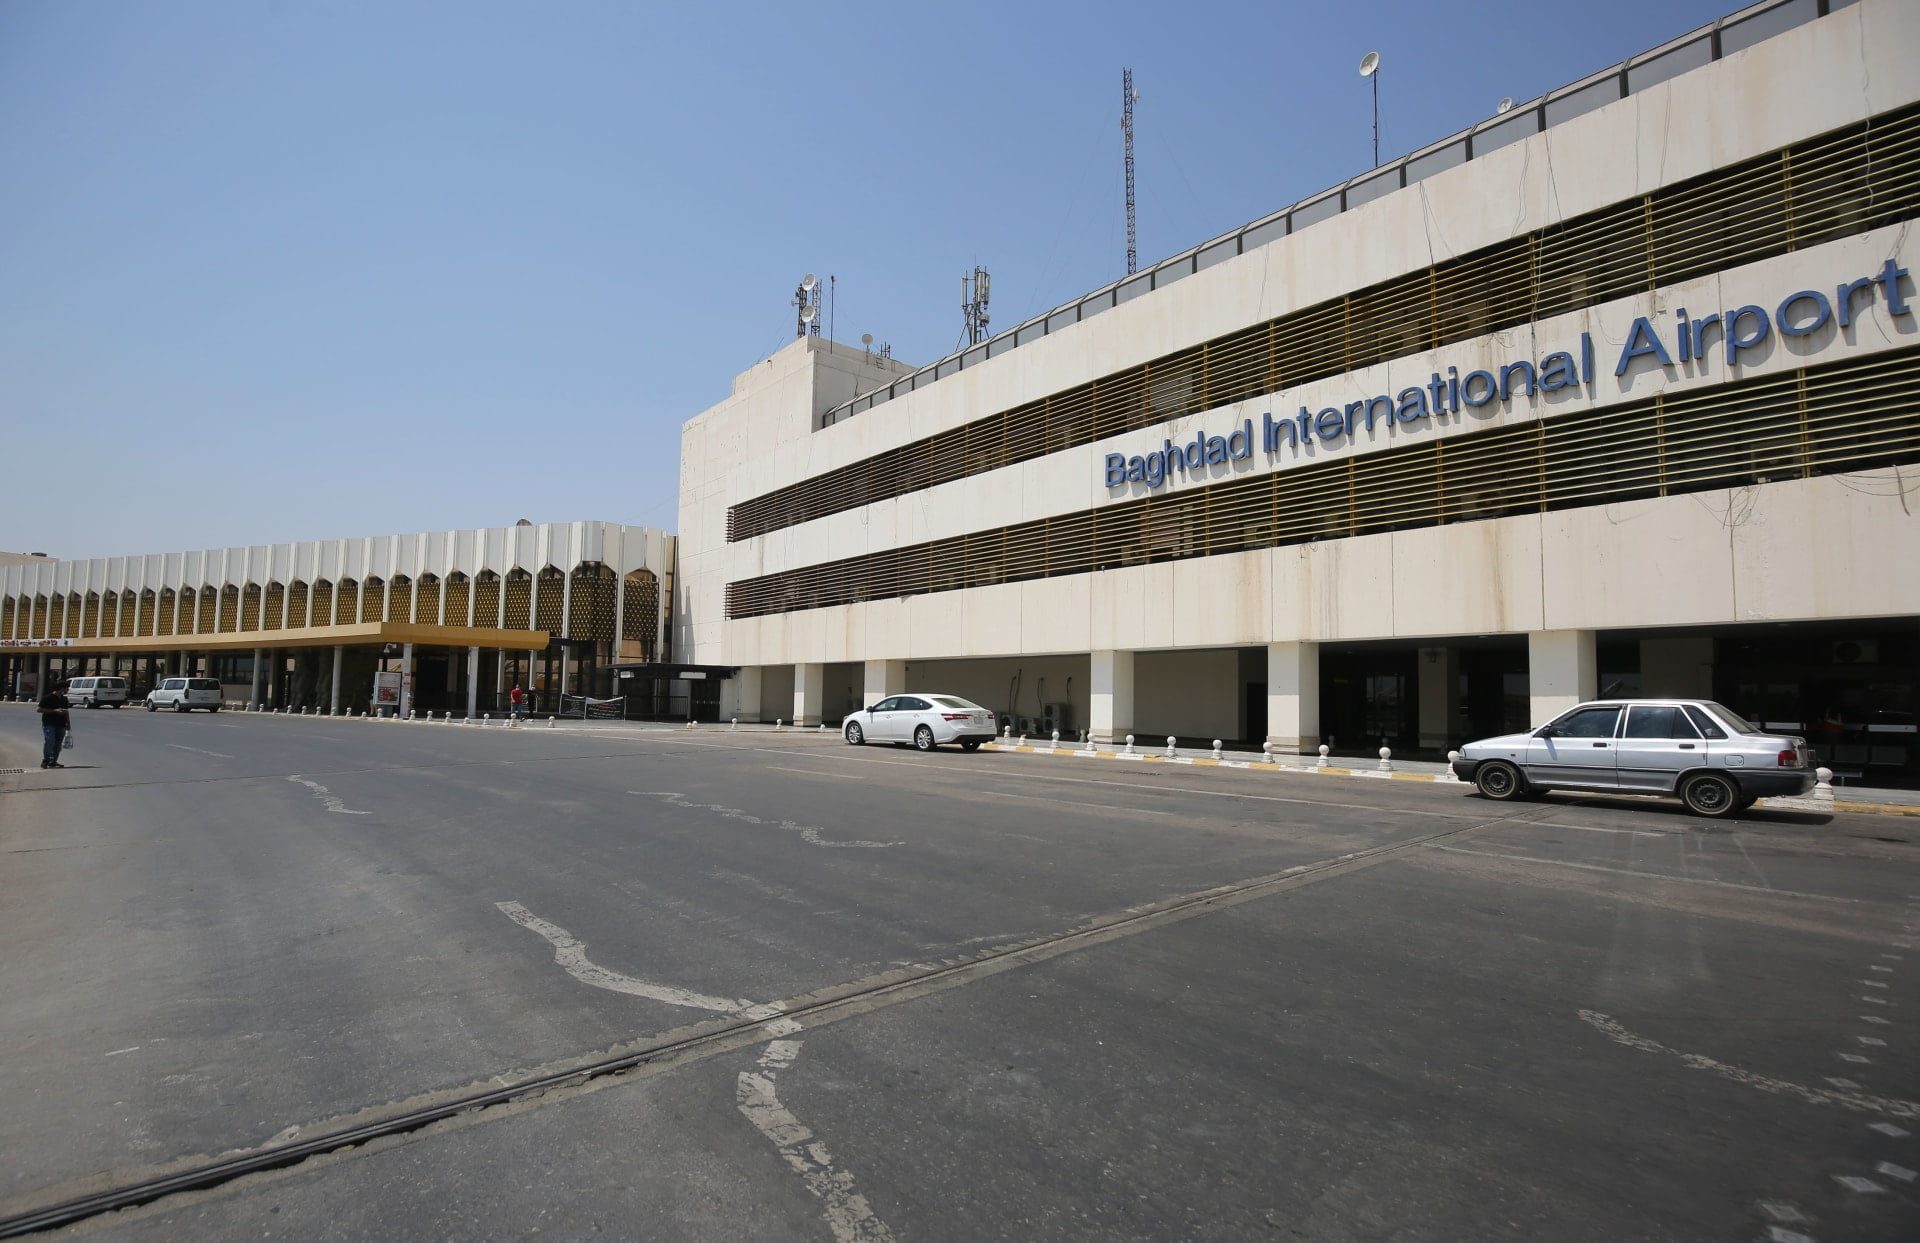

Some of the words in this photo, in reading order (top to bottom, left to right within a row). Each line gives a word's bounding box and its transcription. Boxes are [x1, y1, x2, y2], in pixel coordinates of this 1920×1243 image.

[1105, 418, 1252, 488] Baghdad
[1263, 331, 1591, 454] International
[1615, 258, 1911, 377] Airport
